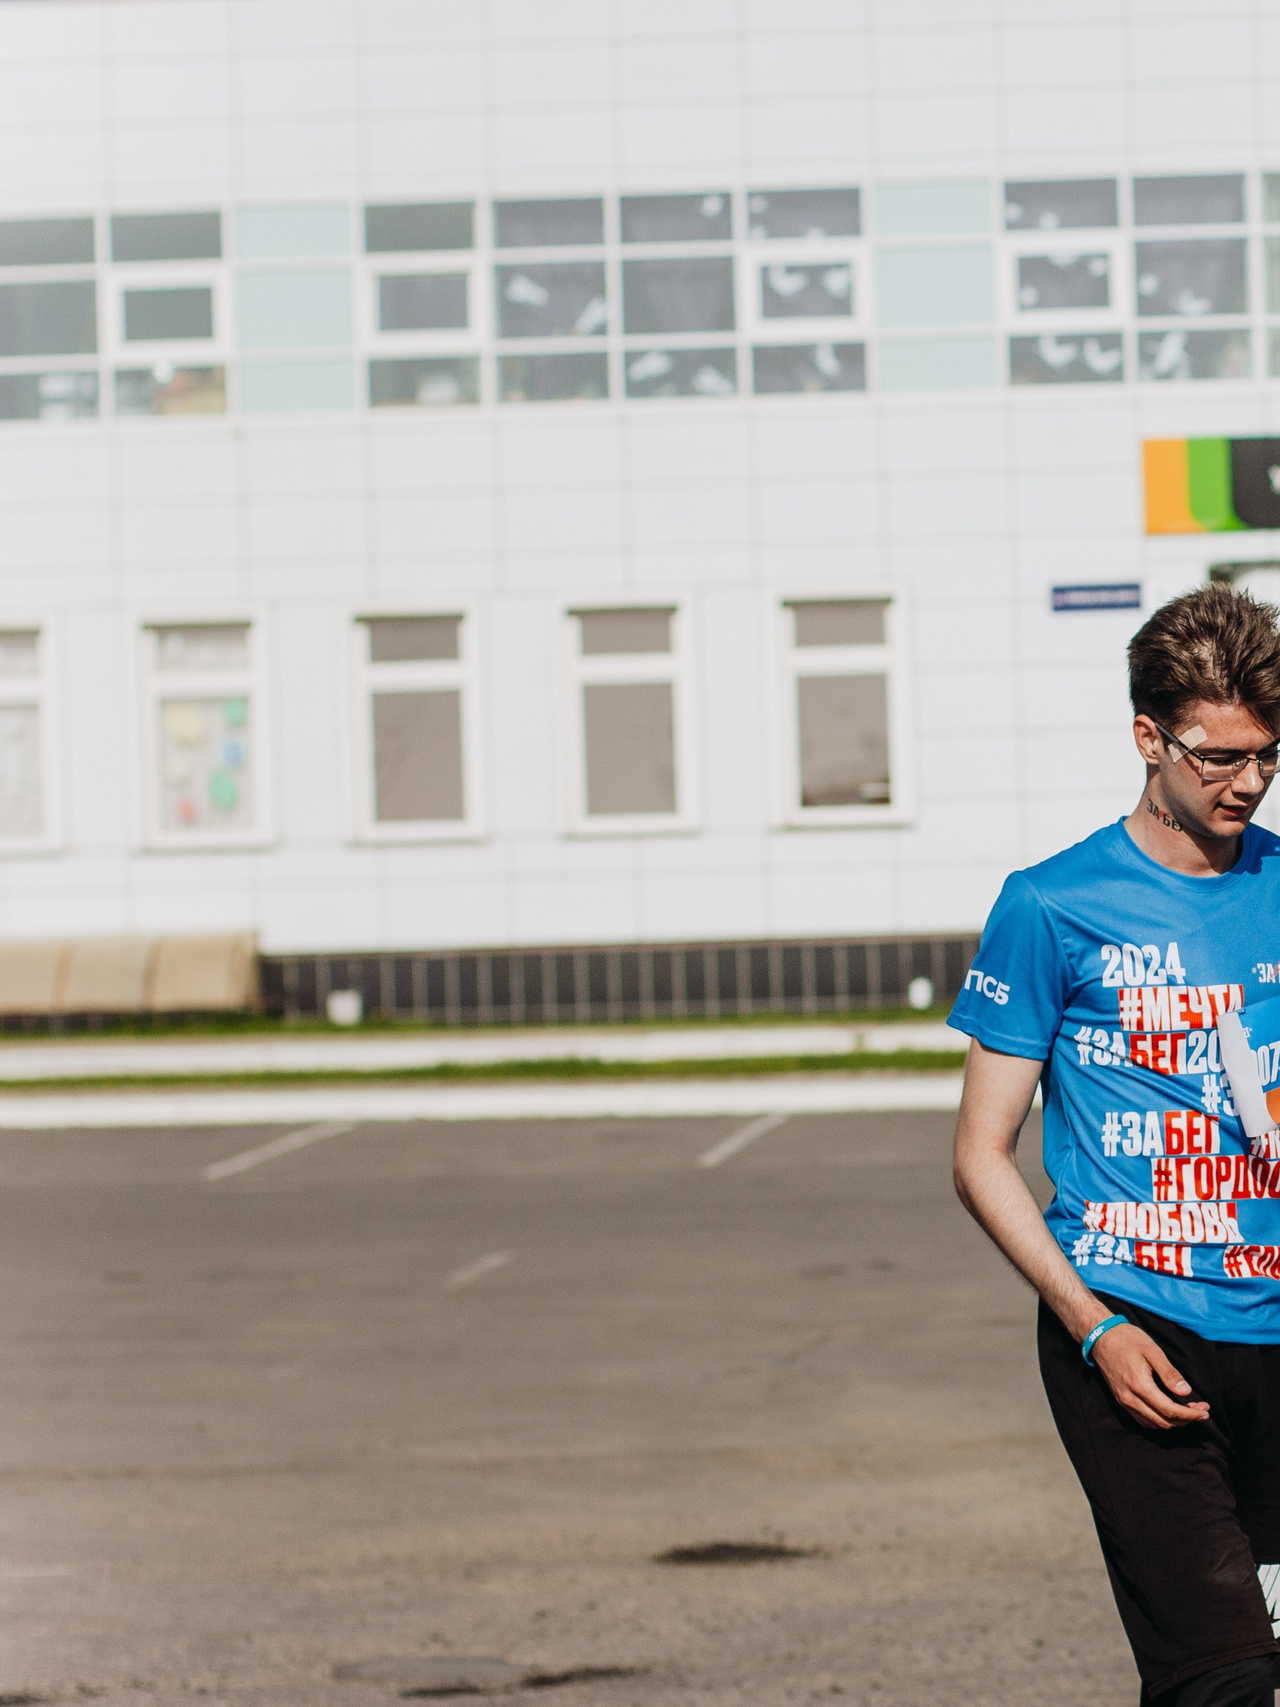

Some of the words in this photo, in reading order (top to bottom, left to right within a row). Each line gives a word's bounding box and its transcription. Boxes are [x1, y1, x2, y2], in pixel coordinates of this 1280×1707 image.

[1101, 942, 1186, 987] 2024
[964, 969, 1010, 1005] ПСБ
[1101, 1110, 1220, 1157] #ЗАБЕГ
[1083, 1200, 1245, 1243] #ЛЮБОВЬ
[1072, 1234, 1193, 1277] #ЗАБЕГ
